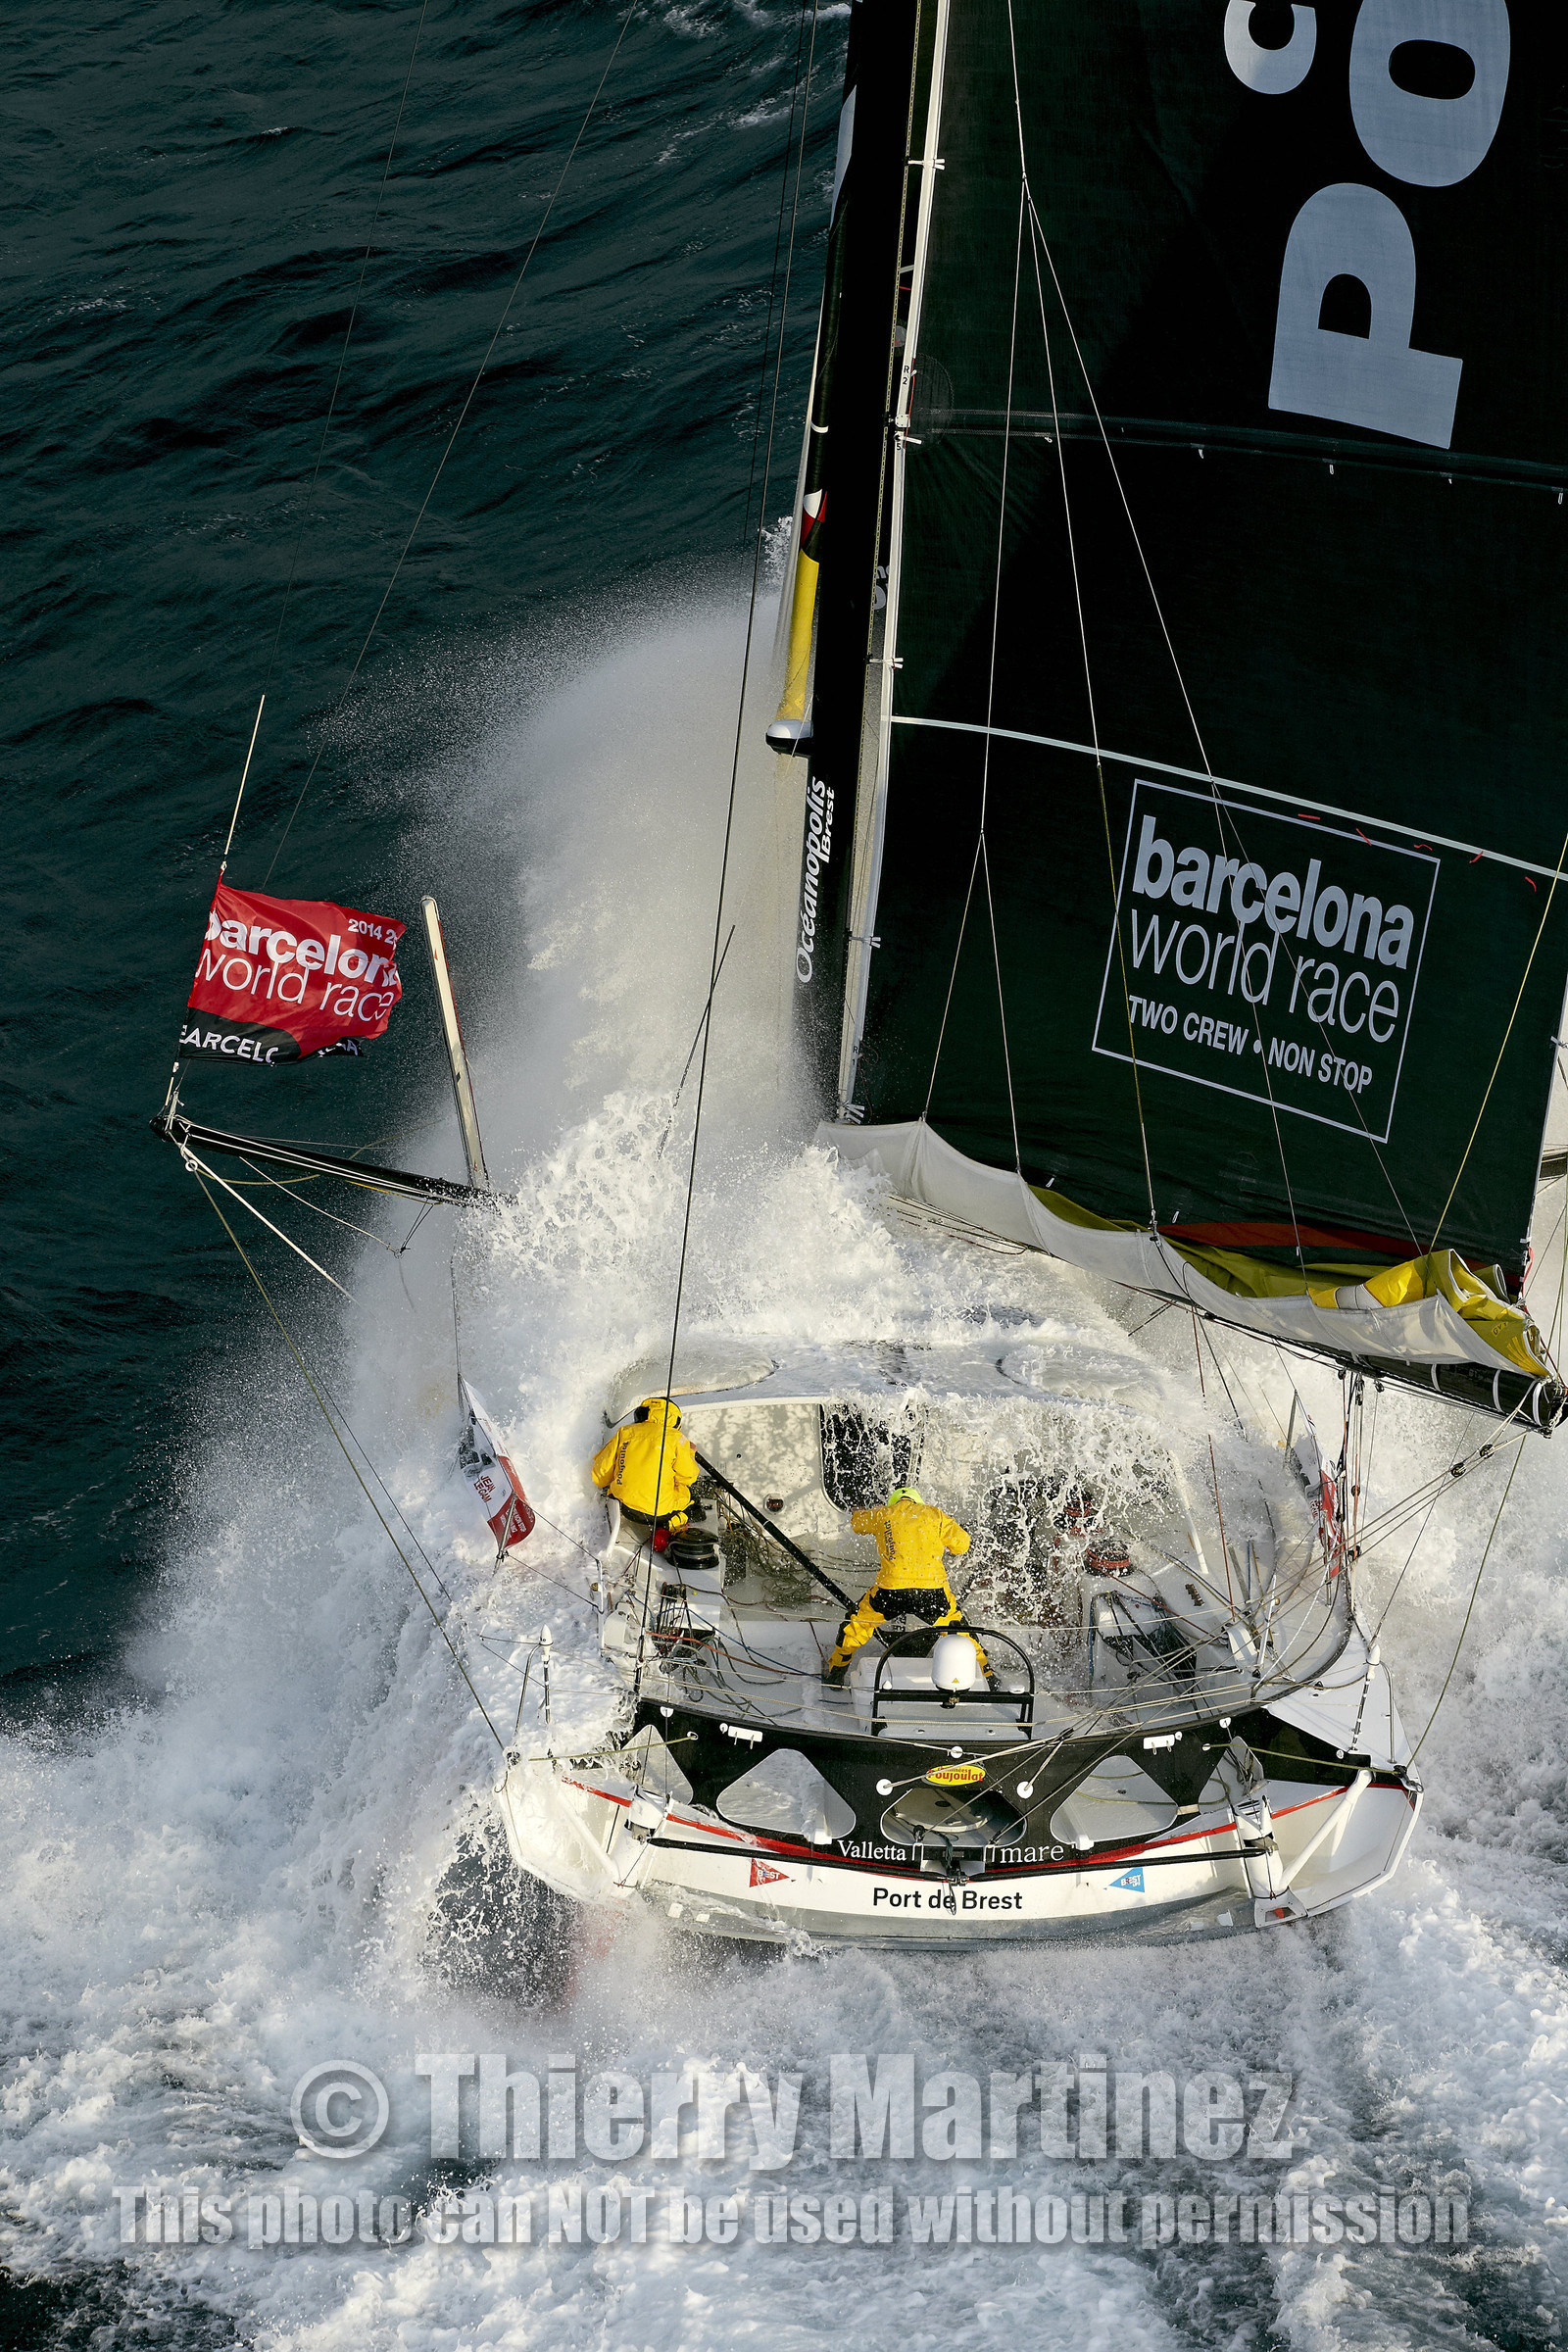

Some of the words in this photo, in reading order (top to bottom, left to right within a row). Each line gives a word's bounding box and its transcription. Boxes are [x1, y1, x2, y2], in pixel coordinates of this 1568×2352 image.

[821, 786, 835, 858] Brest
[796, 776, 830, 983] Océanopolis
[1132, 814, 1414, 969] barcelona
[347, 918, 383, 941] 2014
[1289, 956, 1399, 1043] race
[1128, 995, 1178, 1034] TWO
[1183, 1012, 1249, 1055] CREW
[1268, 1037, 1315, 1077] NON
[1318, 1053, 1372, 1094] STOP
[837, 1838, 907, 1861] Valletta
[1000, 1844, 1064, 1864] mare
[873, 1887, 922, 1909] Port
[928, 1889, 956, 1909] de
[961, 1890, 1023, 1910] Brest
